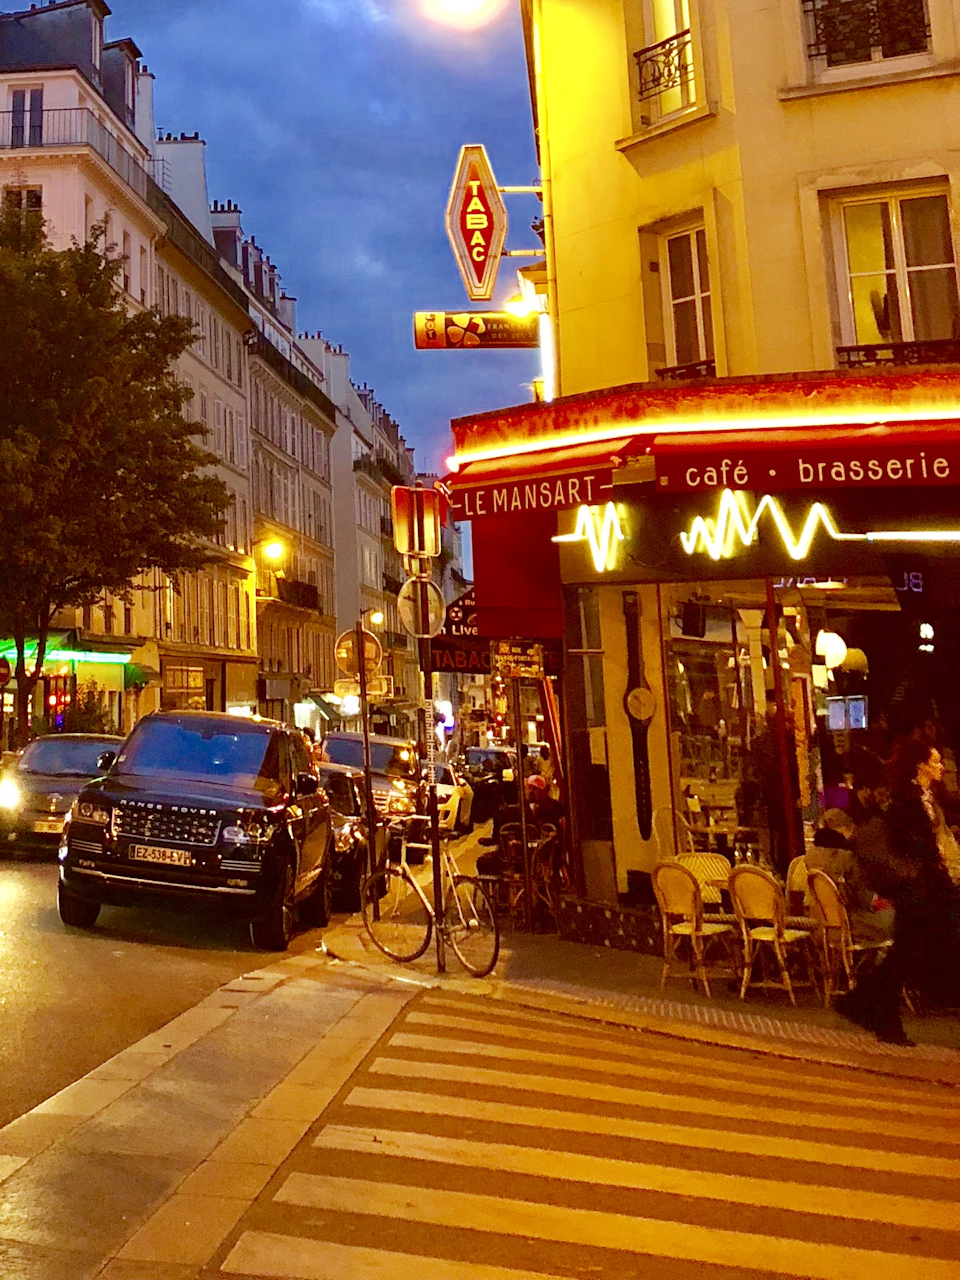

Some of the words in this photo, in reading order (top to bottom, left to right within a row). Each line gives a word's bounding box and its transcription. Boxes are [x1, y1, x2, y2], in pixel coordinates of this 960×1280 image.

[466, 180, 489, 262] TABAC
[685, 459, 749, 487] café
[798, 452, 951, 483] brasserie
[464, 490, 486, 516] LE
[492, 475, 596, 514] MANSART
[119, 799, 163, 810] RANGE
[171, 805, 218, 816] ROVER
[136, 847, 183, 863] EZ-538-EV
